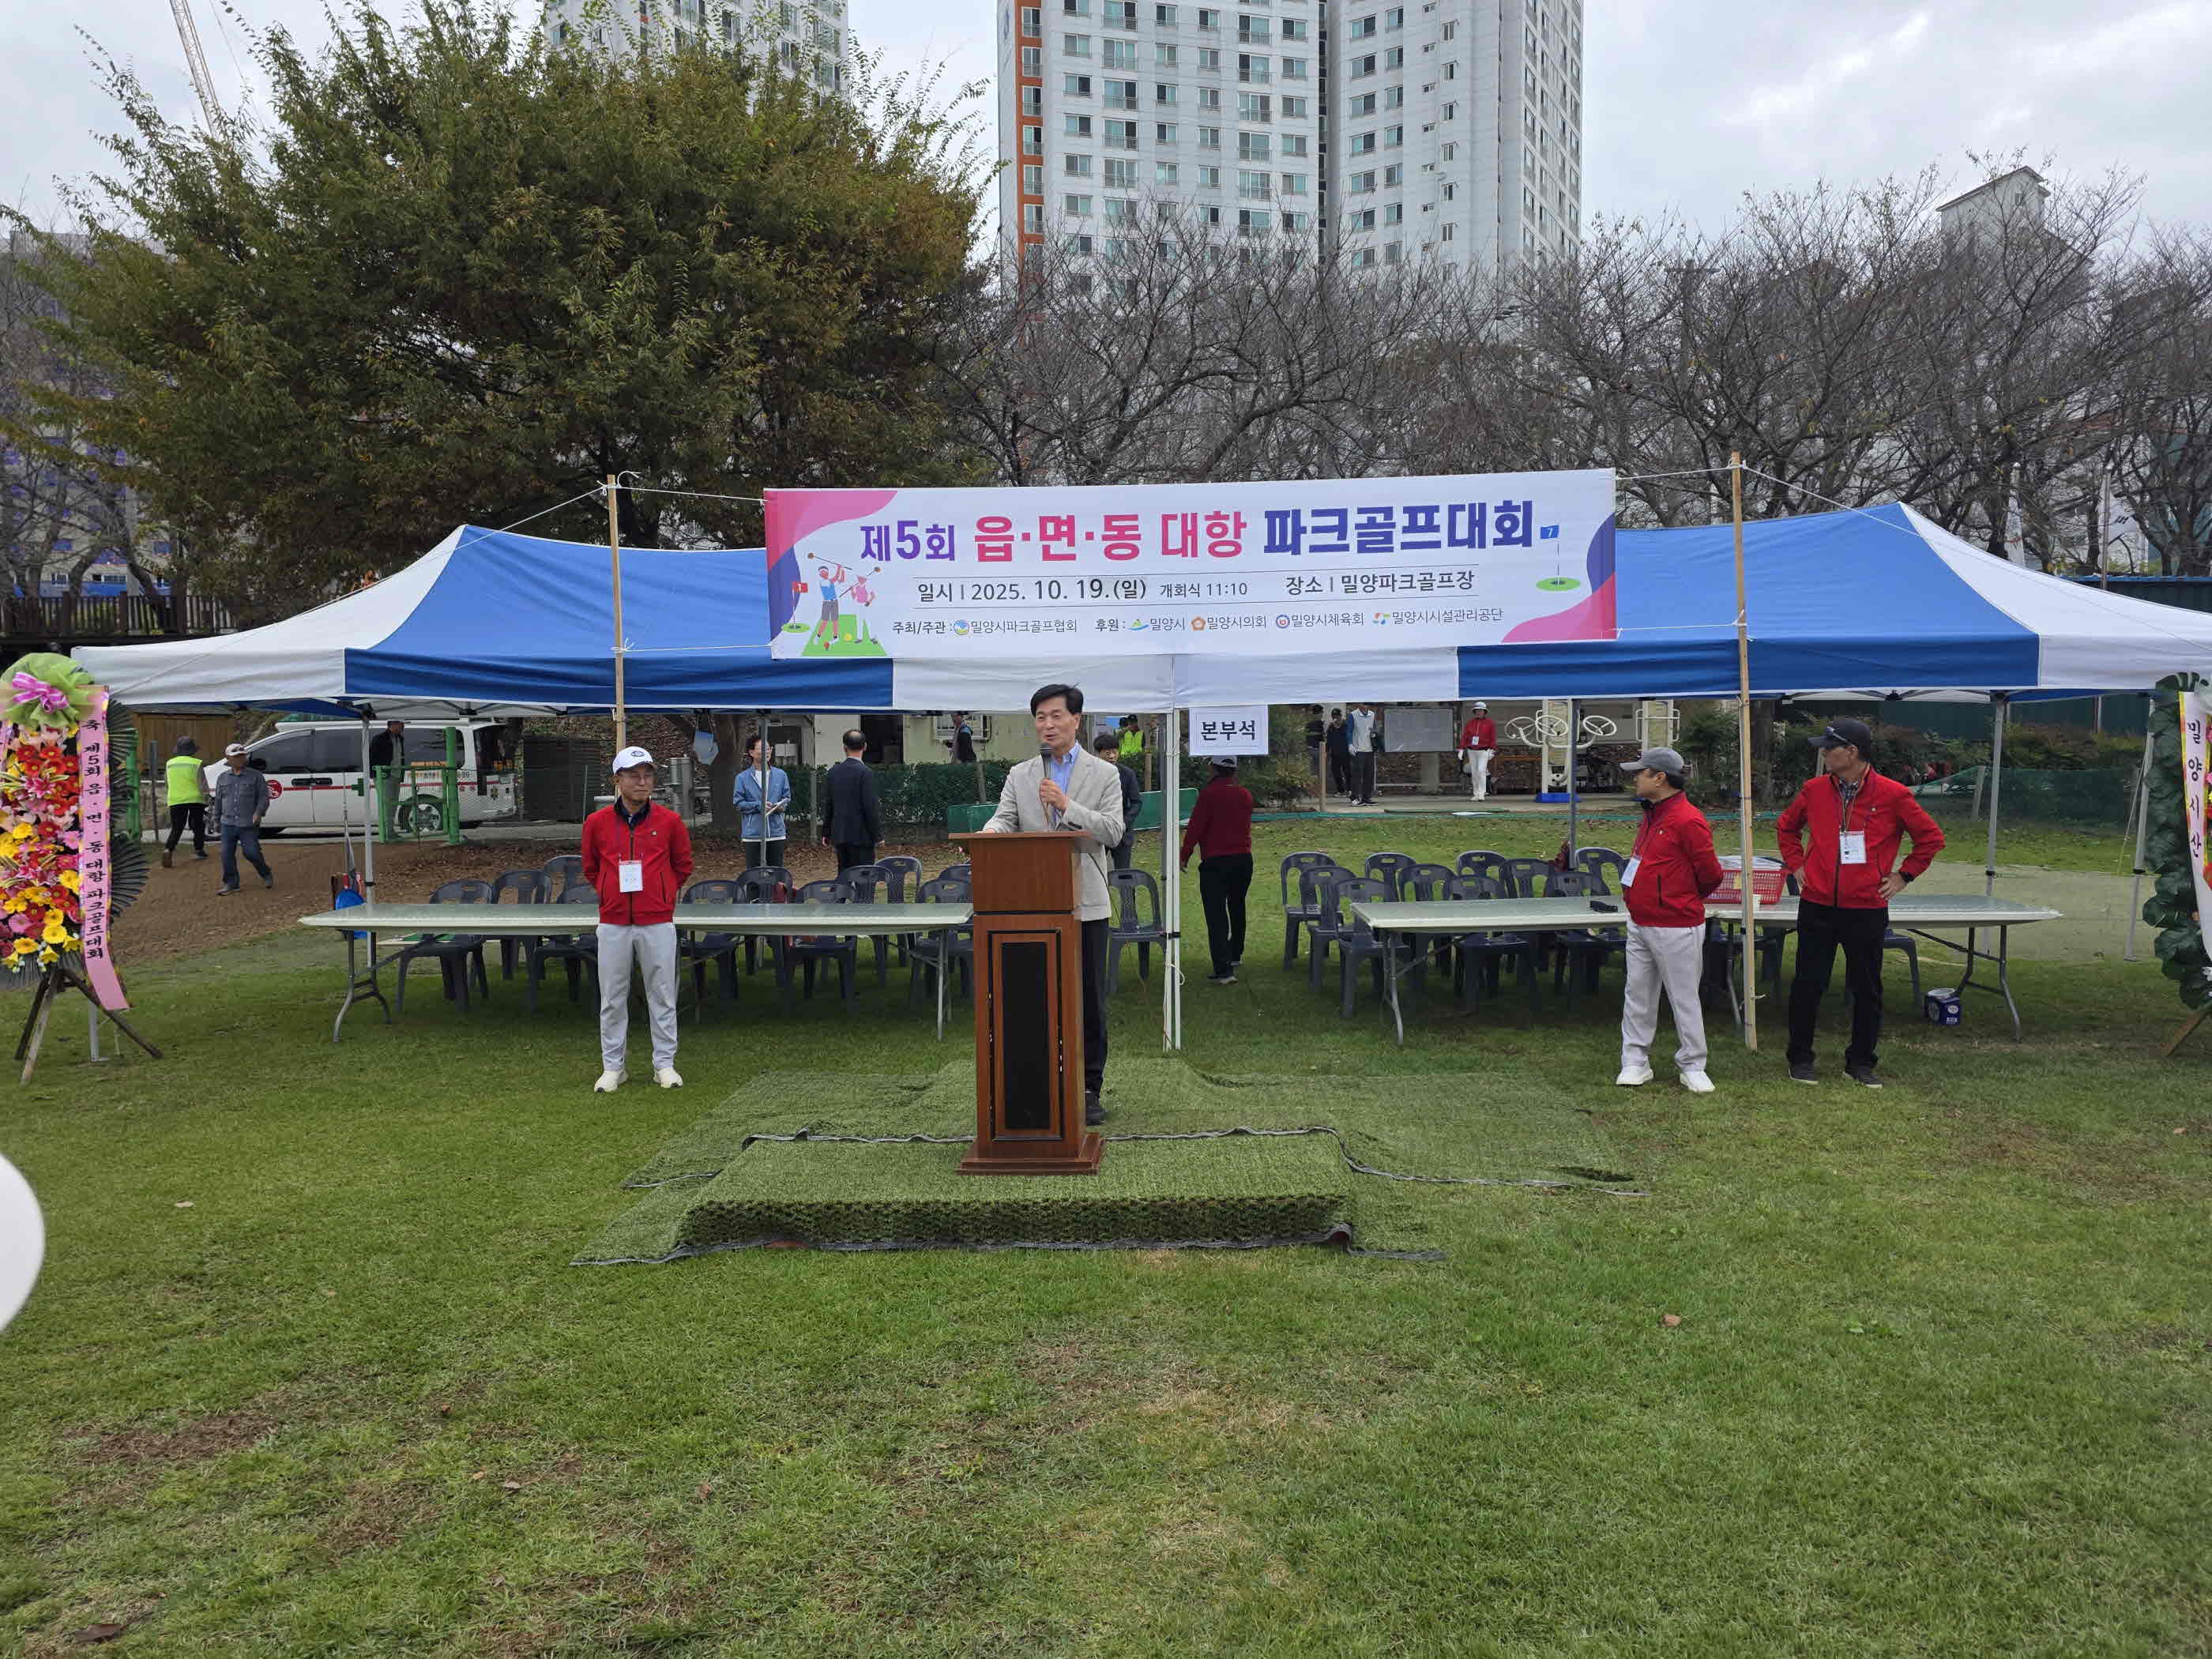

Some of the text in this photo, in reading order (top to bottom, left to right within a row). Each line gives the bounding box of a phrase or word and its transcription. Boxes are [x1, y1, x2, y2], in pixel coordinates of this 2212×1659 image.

[860, 500, 1533, 562] 제5회 읍·면·동 대항 파크골프대회
[918, 584, 953, 602] 일시
[971, 583, 1025, 601] 2025.
[1034, 580, 1068, 600] 10.
[1076, 578, 1147, 600] 19.(일)
[1160, 582, 1201, 598] 개회식
[1206, 581, 1247, 596] 11:10
[1285, 576, 1323, 596] 장소
[1341, 570, 1475, 593] 밀양파크골프장
[971, 619, 1077, 634] 밀양시파크골프협회
[1150, 617, 1185, 631] 밀양시
[1207, 615, 1266, 630] 밀양시의회
[1291, 612, 1364, 627] 밀양시체육회
[1392, 608, 1503, 623] 밀양시시설관리공단
[1201, 720, 1255, 741] 본부석
[84, 743, 101, 777] 제5회
[85, 859, 106, 882] 대항
[85, 888, 106, 959] 파크골프대회
